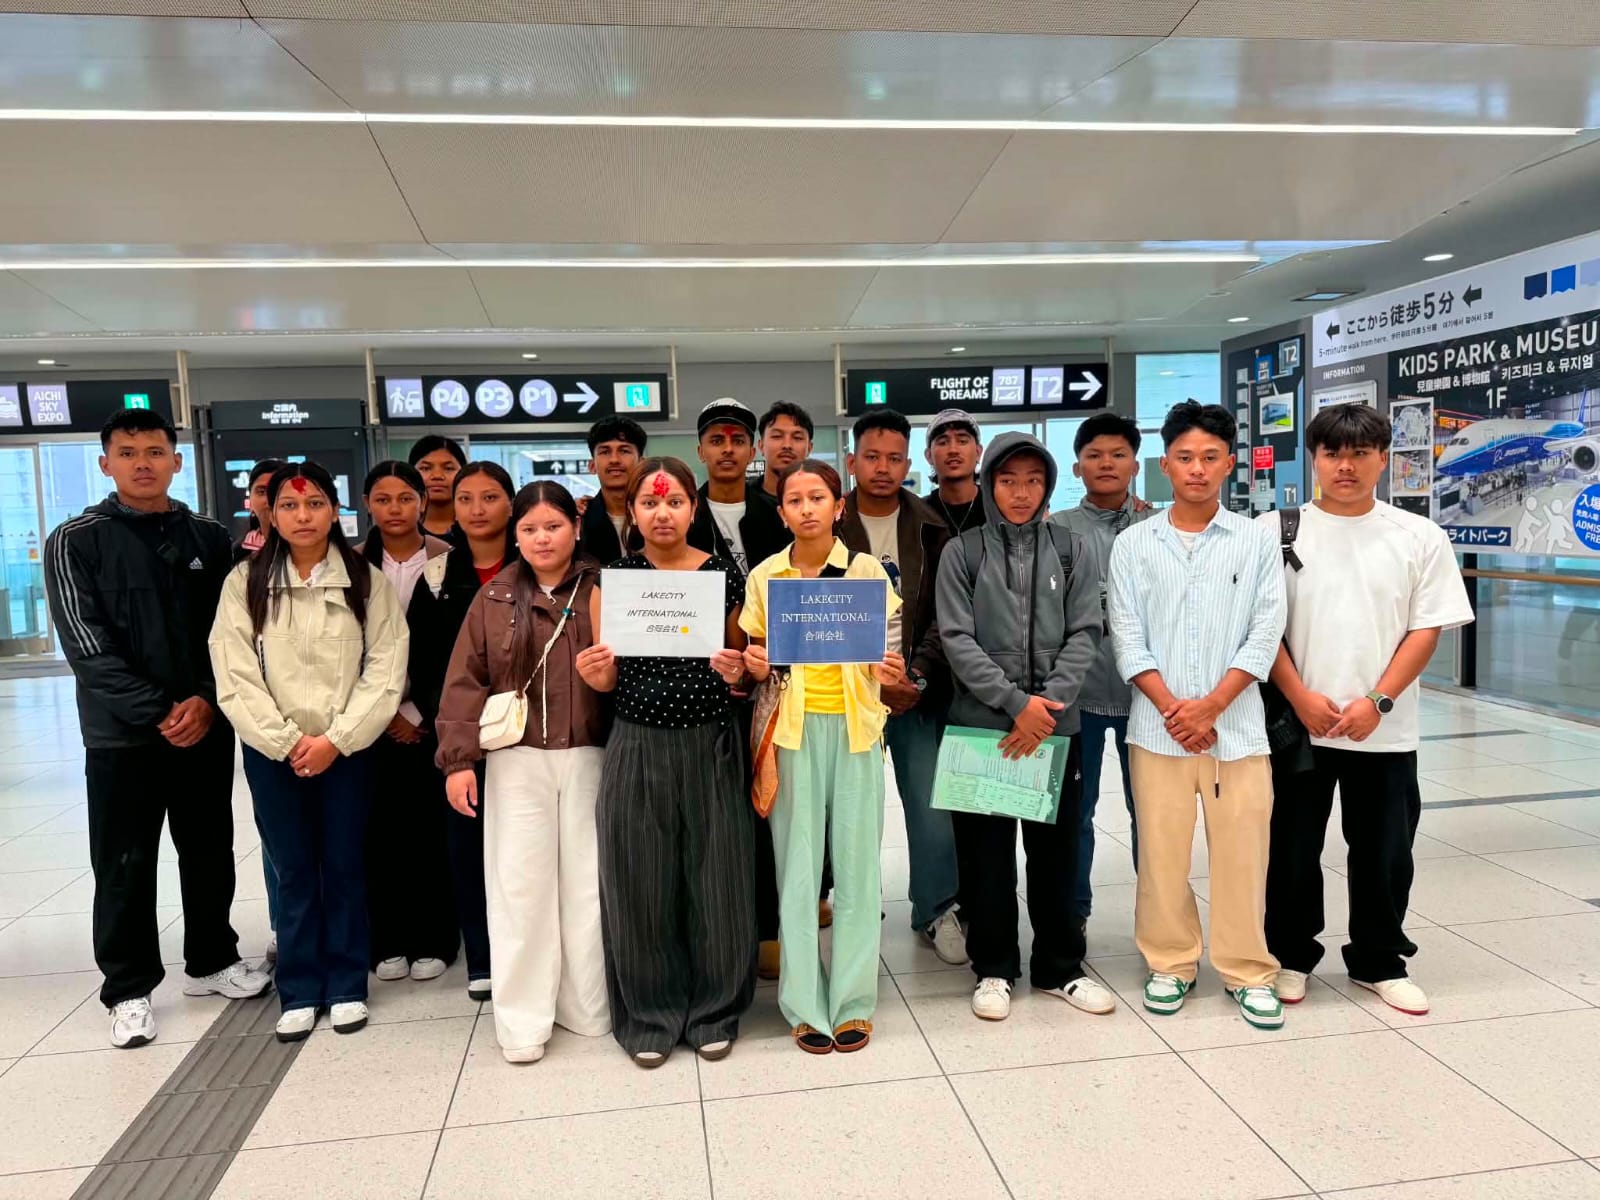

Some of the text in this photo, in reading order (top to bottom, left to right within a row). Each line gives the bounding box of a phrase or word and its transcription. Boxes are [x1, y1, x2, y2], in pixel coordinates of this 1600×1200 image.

[1346, 290, 1455, 335] ここから徒歩5分
[1284, 345, 1297, 363] T2
[1399, 320, 1598, 377] KIDS PARK & MUSEU
[1323, 364, 1365, 380] INFORMATION
[1501, 353, 1594, 380] 키즈파크 & 뮤지엄
[930, 376, 990, 390] FLIGHT OF
[998, 375, 1018, 386] 787
[1032, 376, 1062, 399] T2
[34, 391, 61, 401] AICHI
[434, 387, 466, 411] P4
[479, 387, 510, 411] P3
[525, 387, 552, 410] P1
[940, 388, 989, 400] DREAMS
[1486, 386, 1508, 409] 1F
[39, 401, 58, 412] SKY
[37, 412, 64, 422] EXPO
[262, 411, 309, 420] Information
[1284, 487, 1296, 503] T1
[641, 591, 686, 600] LAKECITY
[800, 594, 853, 604] LAKECITY
[627, 609, 698, 618] INTERNATIONAL
[781, 612, 871, 623] INTERNATIONAL
[805, 630, 845, 641] 合同会社
